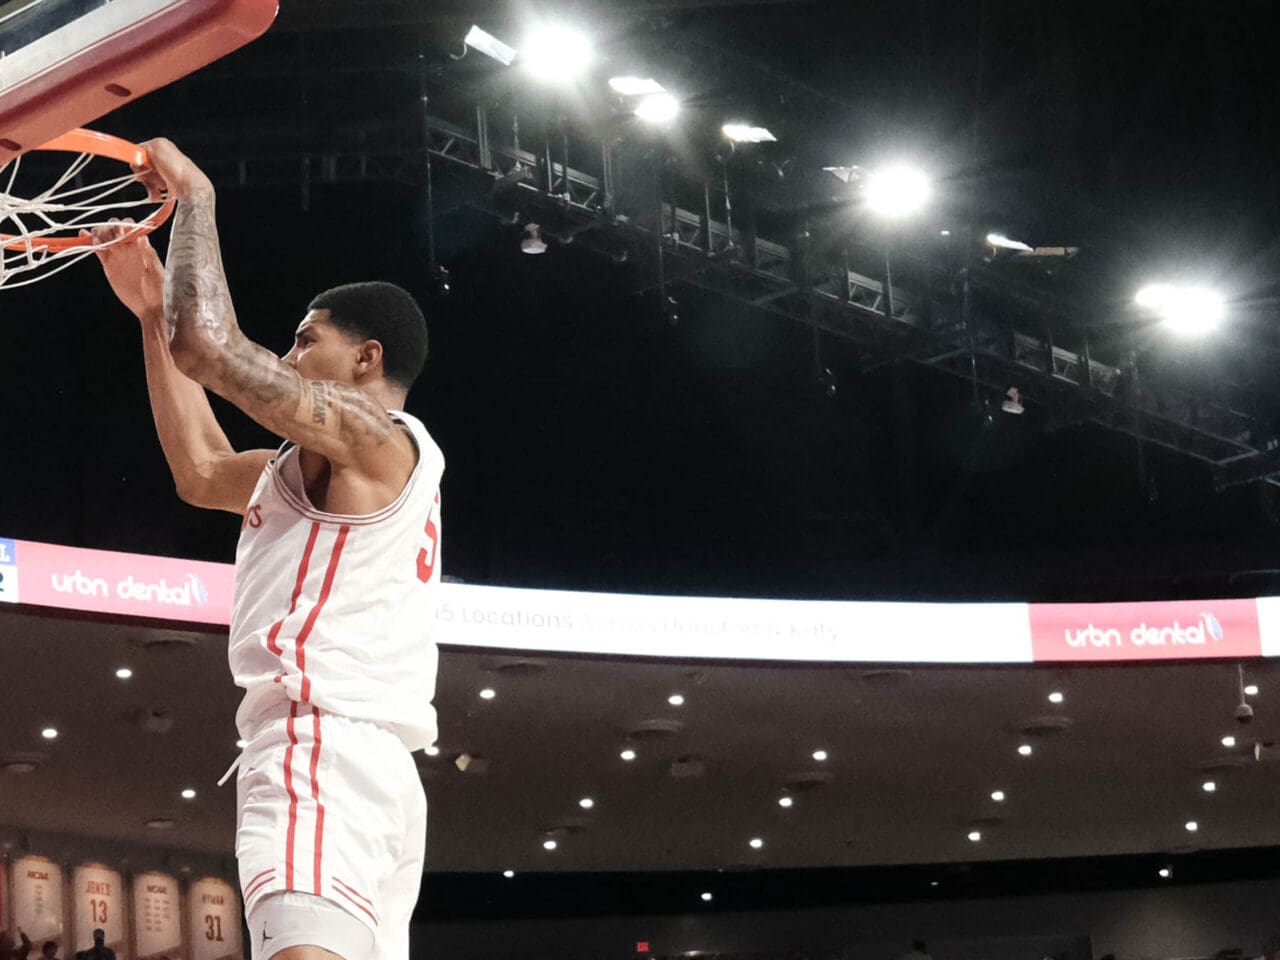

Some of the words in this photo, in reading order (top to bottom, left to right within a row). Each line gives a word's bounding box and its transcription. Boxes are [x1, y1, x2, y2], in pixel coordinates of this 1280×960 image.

[51, 569, 108, 597] urbn
[117, 575, 191, 606] dental
[1065, 623, 1120, 647] urbn
[1130, 620, 1205, 647] dental
[90, 898, 108, 923] 13
[205, 914, 224, 942] 31
